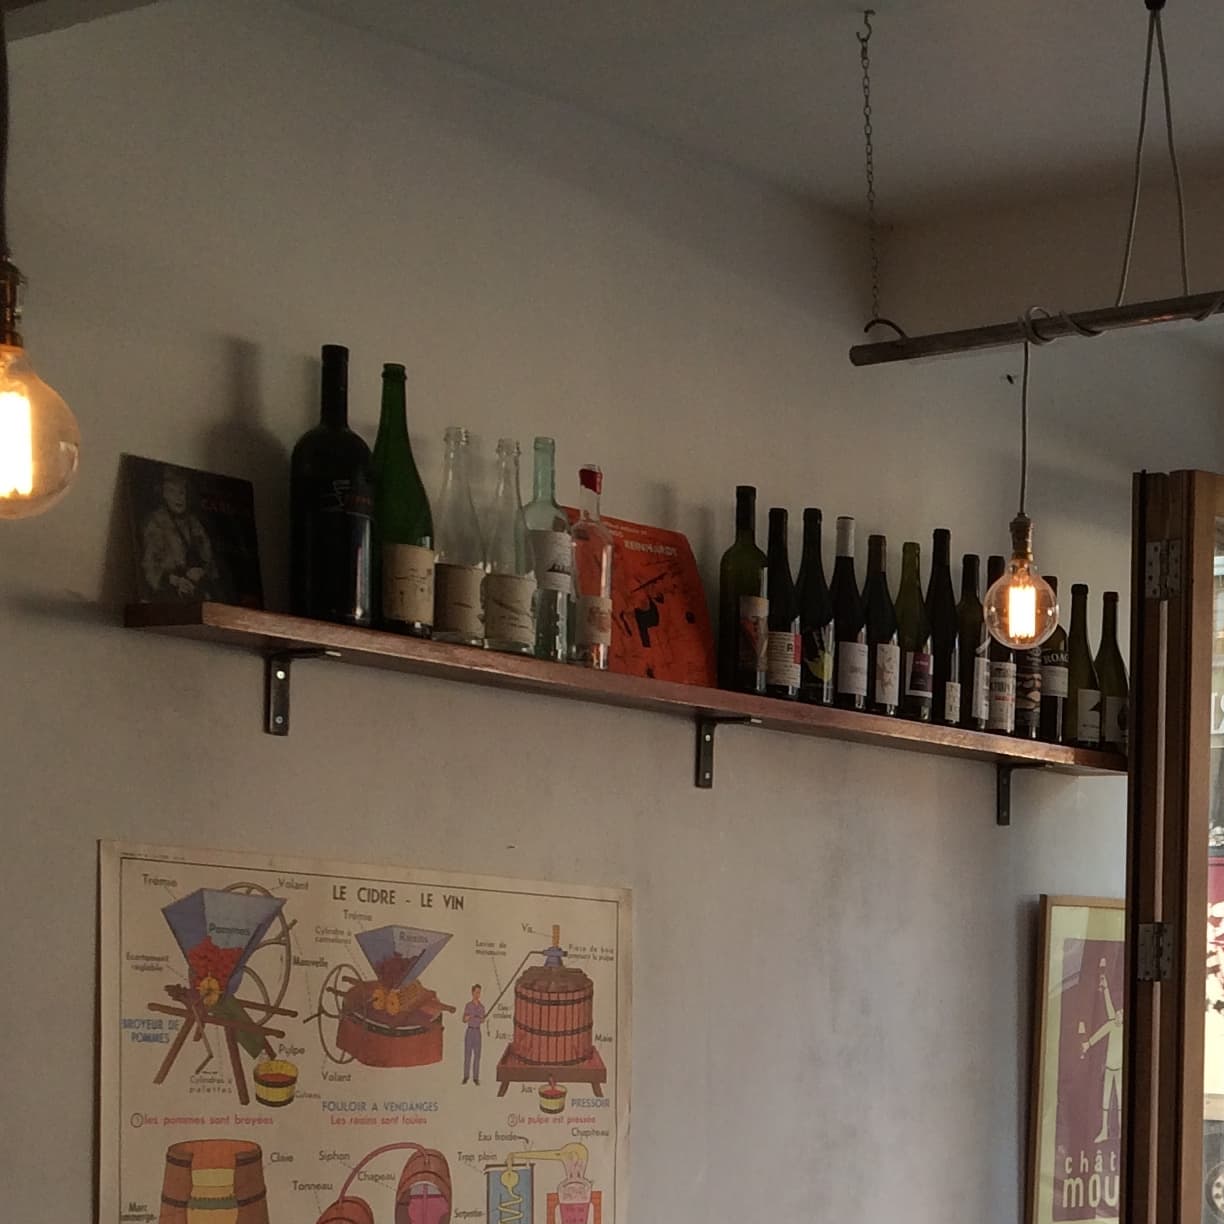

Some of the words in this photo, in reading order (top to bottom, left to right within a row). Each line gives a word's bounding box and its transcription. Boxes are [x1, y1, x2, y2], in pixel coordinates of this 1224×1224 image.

[333, 885, 347, 900] LE
[357, 887, 397, 905] CIDRE
[420, 892, 433, 908] LE
[443, 894, 464, 911] VIN
[321, 1070, 352, 1082] Volant
[321, 1101, 367, 1112] FOULOIR
[371, 1101, 378, 1111] A
[384, 1101, 439, 1112] VENDANGES
[571, 1098, 610, 1108] PRESSOIR
[163, 1115, 206, 1127] pommes
[209, 1115, 230, 1125] sont
[330, 1115, 346, 1125] Les
[381, 1114, 400, 1125] sont
[528, 1114, 549, 1125] pulpe
[319, 1150, 350, 1162] Siphon
[358, 1171, 395, 1183] Chapeau
[292, 1180, 333, 1191] Tonneau
